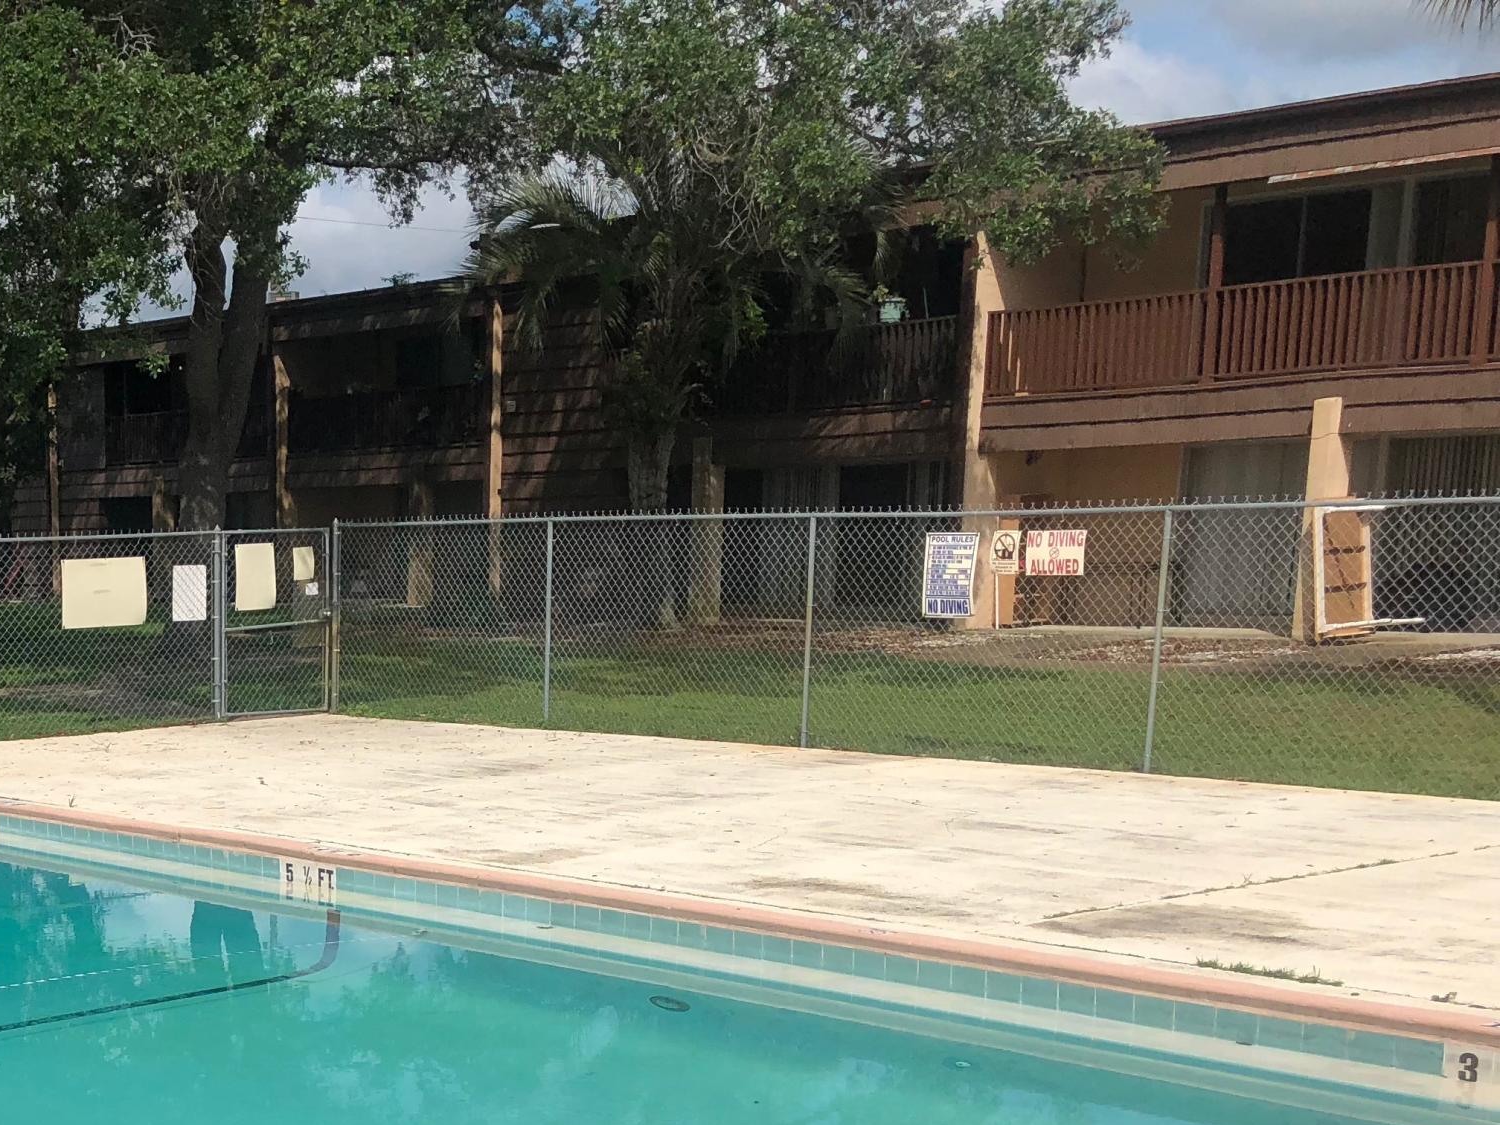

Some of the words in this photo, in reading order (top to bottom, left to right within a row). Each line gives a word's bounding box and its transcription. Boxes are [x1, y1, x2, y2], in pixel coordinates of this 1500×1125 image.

[1027, 532, 1043, 548] NO
[1048, 531, 1085, 548] DIVING
[1030, 558, 1079, 575] ALLOWED
[927, 599, 938, 614] NO
[940, 599, 969, 615] DIVING
[285, 862, 294, 882] 5
[1457, 1052, 1479, 1083] 3
